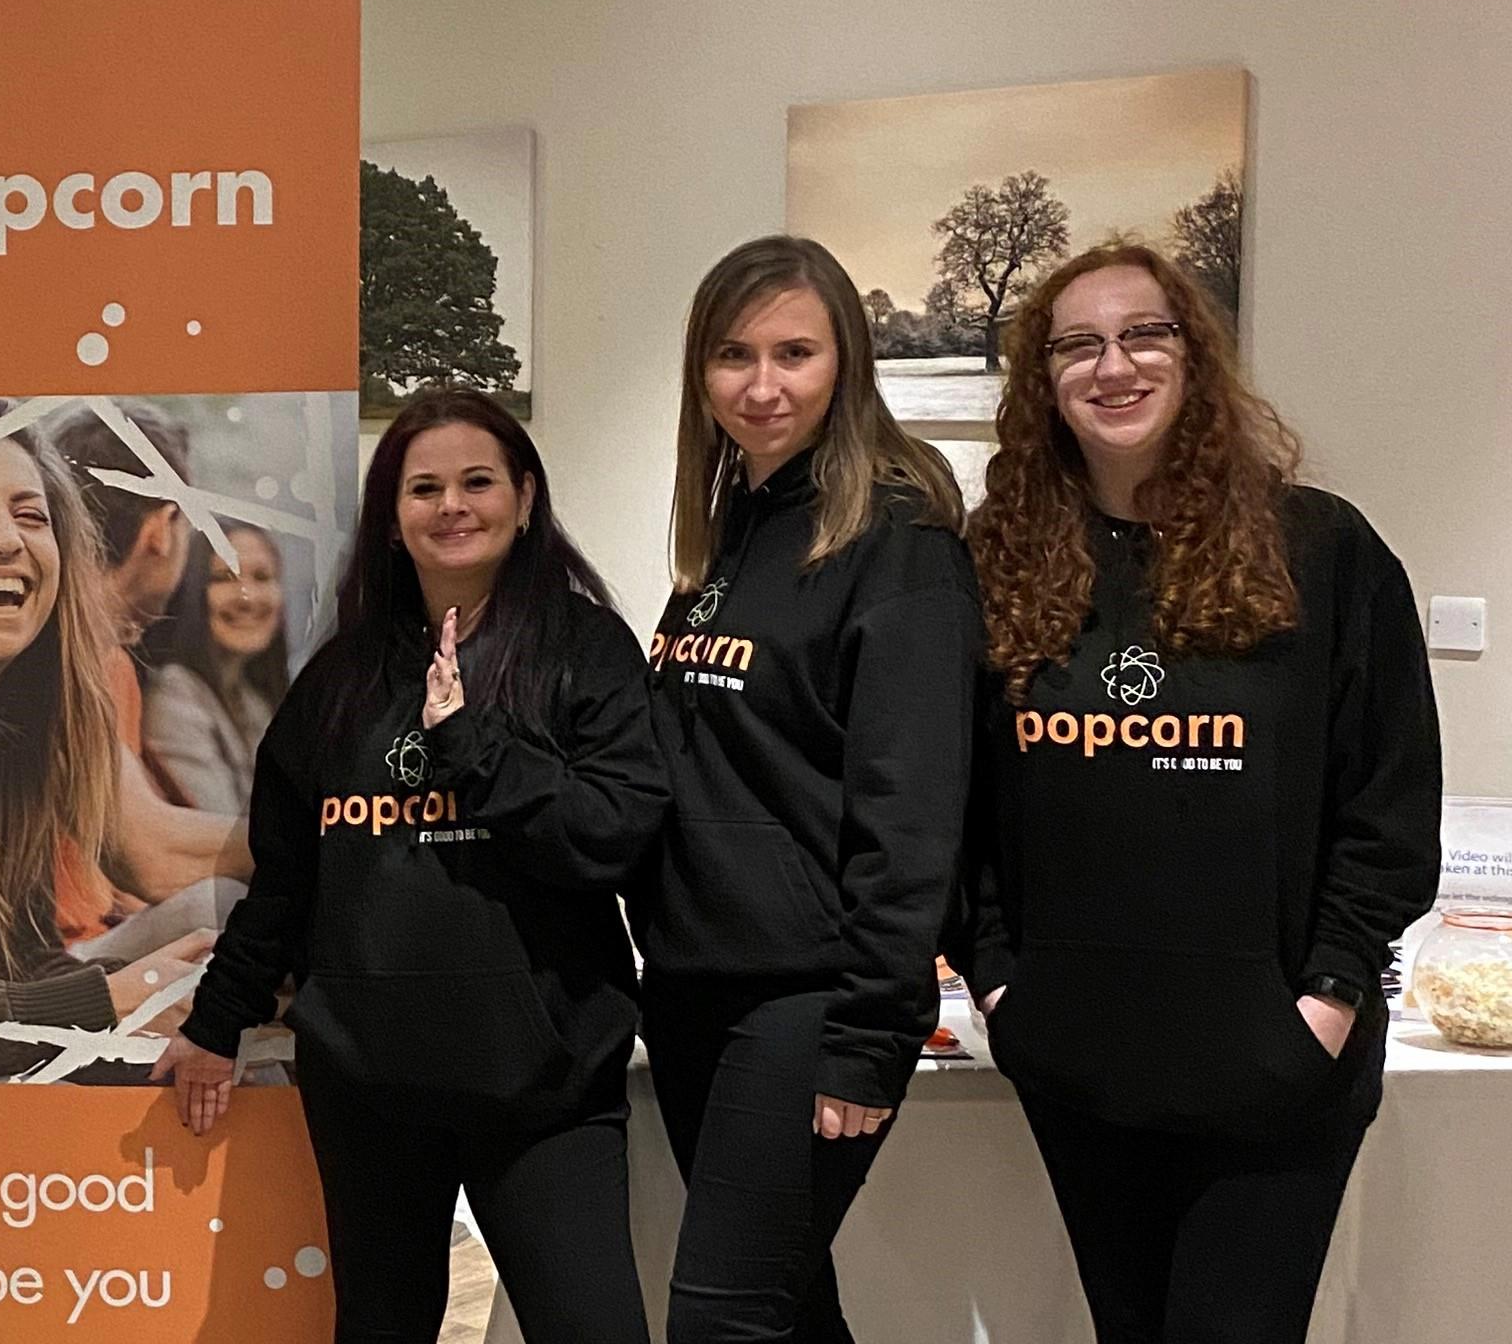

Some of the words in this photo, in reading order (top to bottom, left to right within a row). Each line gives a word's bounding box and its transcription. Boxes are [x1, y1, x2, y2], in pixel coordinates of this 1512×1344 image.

[1016, 711, 1244, 758] popcorn
[1196, 757, 1209, 771] TO
[1209, 757, 1223, 771] BE
[1222, 758, 1243, 771] YOU
[1448, 848, 1488, 863] Video
[1473, 864, 1487, 875] at
[0, 1146, 154, 1228] good
[63, 1269, 171, 1325] you
